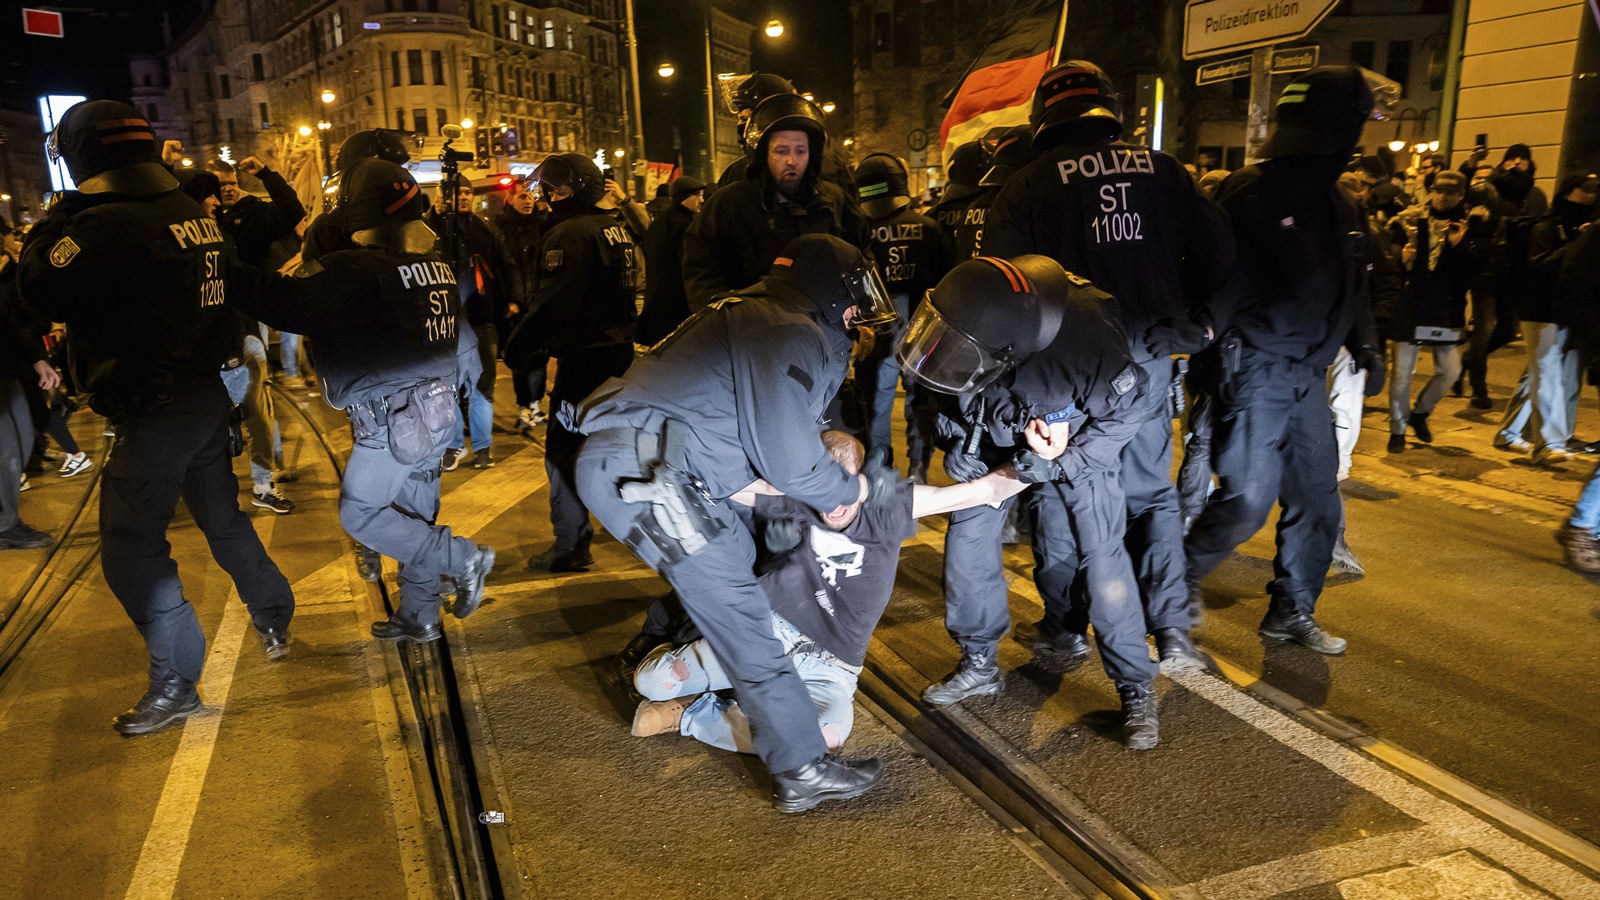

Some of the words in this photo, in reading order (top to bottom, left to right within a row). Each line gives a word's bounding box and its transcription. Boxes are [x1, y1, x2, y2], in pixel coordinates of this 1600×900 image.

[1205, 1, 1299, 34] Polizeidirektion
[1057, 149, 1155, 185] POLIZEI
[1099, 182, 1132, 213] ST
[964, 208, 986, 226] POL
[1091, 212, 1143, 243] 11002
[169, 218, 225, 249] POLIZE
[205, 251, 220, 278] ST
[888, 245, 909, 264] ST
[397, 261, 457, 289] POLIZE
[200, 279, 225, 308] 11203
[429, 289, 449, 315] ST
[425, 315, 455, 341] 11411
